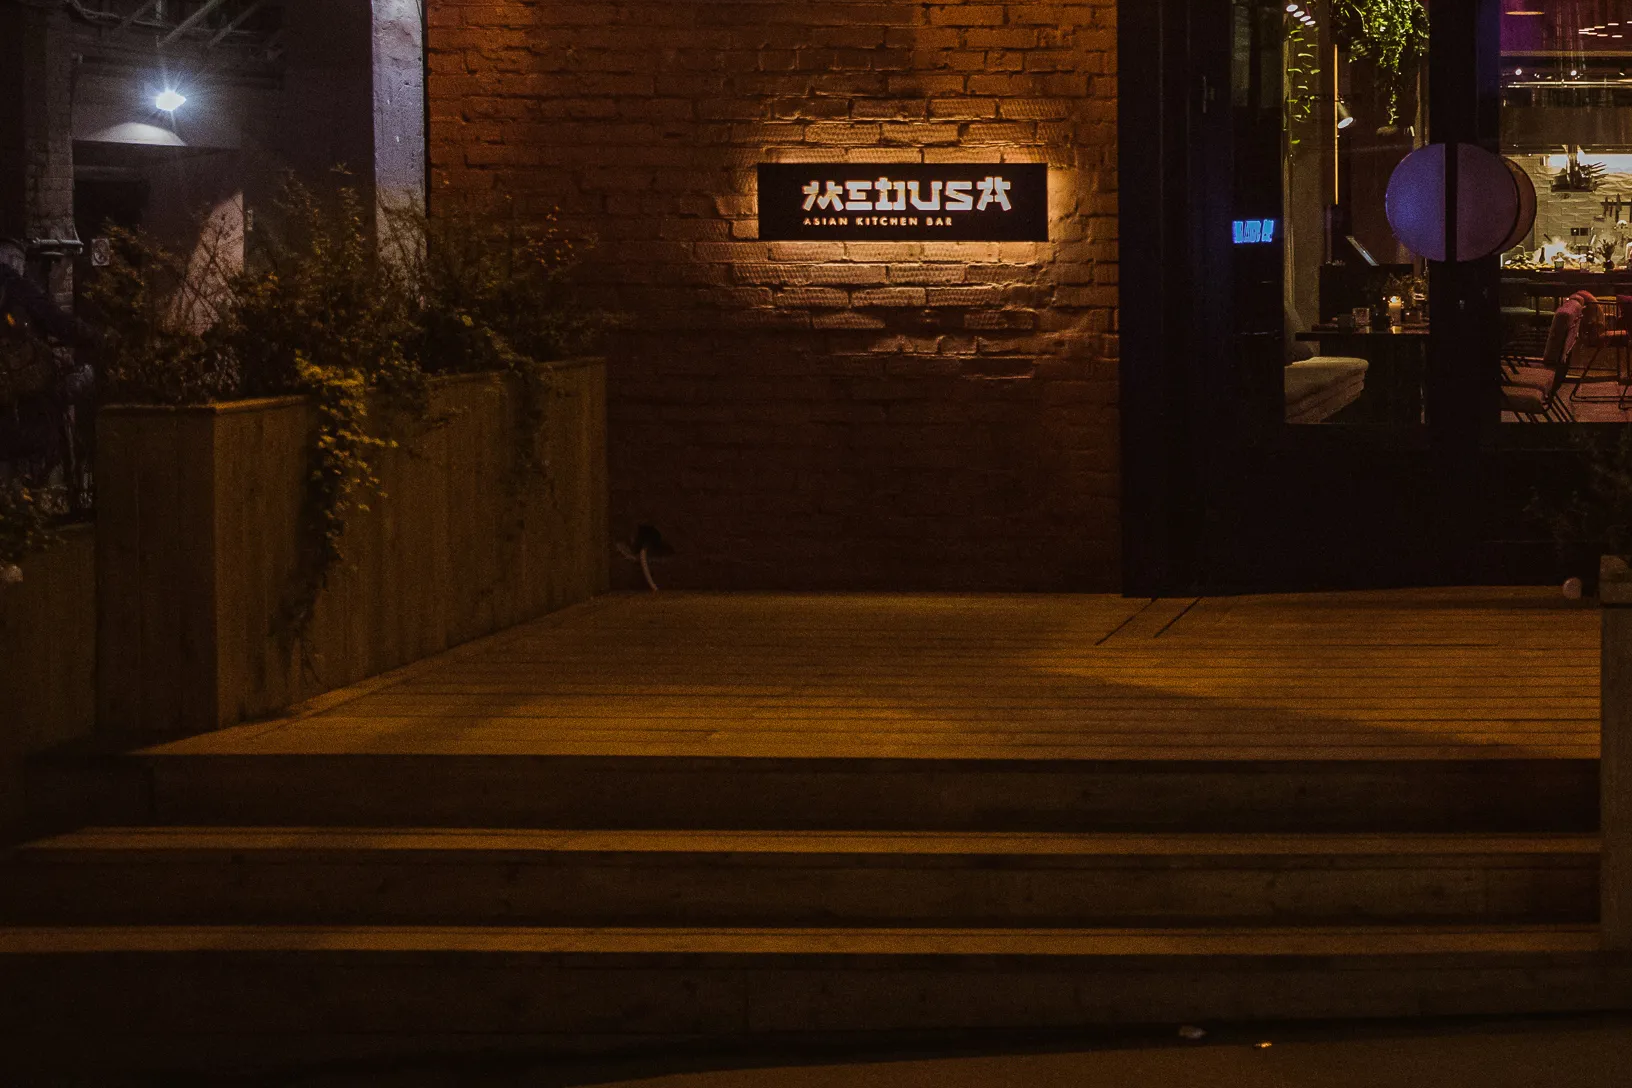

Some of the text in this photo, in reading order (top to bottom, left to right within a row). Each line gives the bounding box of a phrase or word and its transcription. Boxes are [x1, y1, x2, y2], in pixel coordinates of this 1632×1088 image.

[802, 176, 1012, 212] MEDUSA
[803, 216, 952, 226] ASIAN KITCHEN BAR
